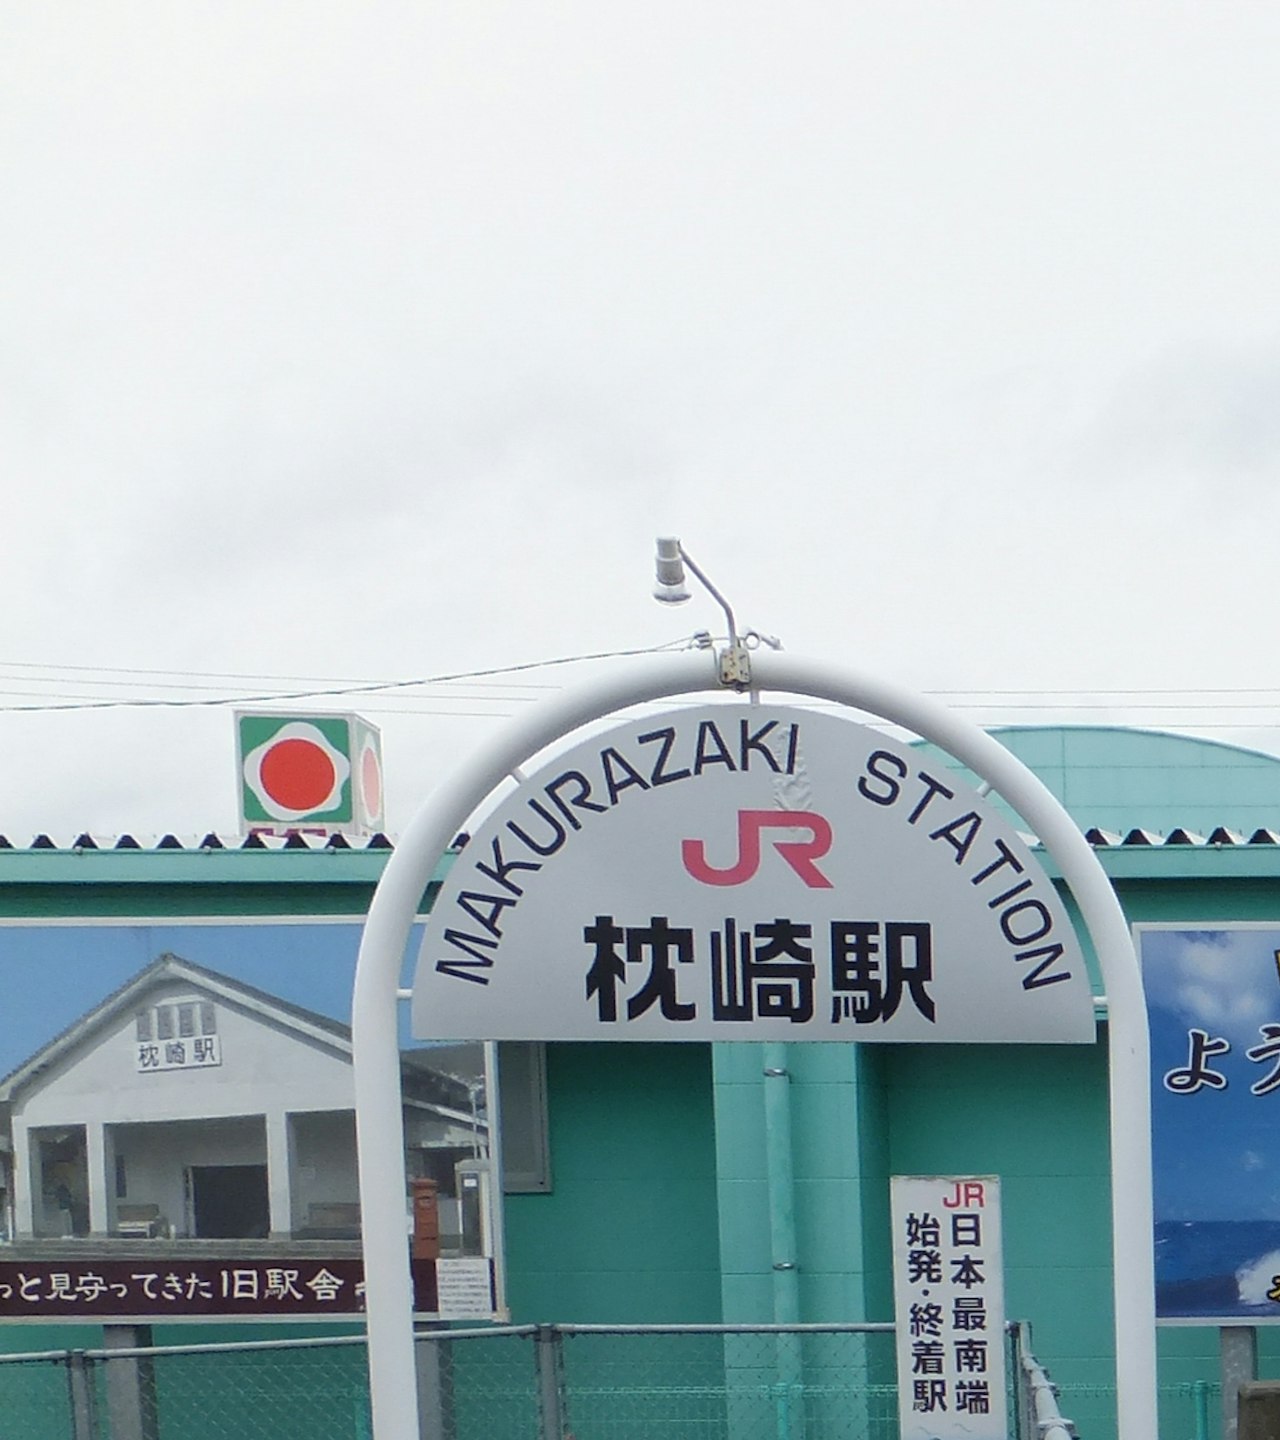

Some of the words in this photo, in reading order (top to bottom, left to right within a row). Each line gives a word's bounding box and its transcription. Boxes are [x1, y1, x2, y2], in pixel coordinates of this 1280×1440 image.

[434, 718, 800, 986] MAKURAZAKI
[857, 750, 1072, 991] STATION
[681, 809, 834, 888] JR
[584, 916, 936, 1024] 枕崎駅
[138, 1038, 217, 1068] 枕崎駅
[944, 1183, 984, 1208] JR
[906, 1212, 947, 1414] 始発・終着駅
[950, 1213, 990, 1414] 日本最南端
